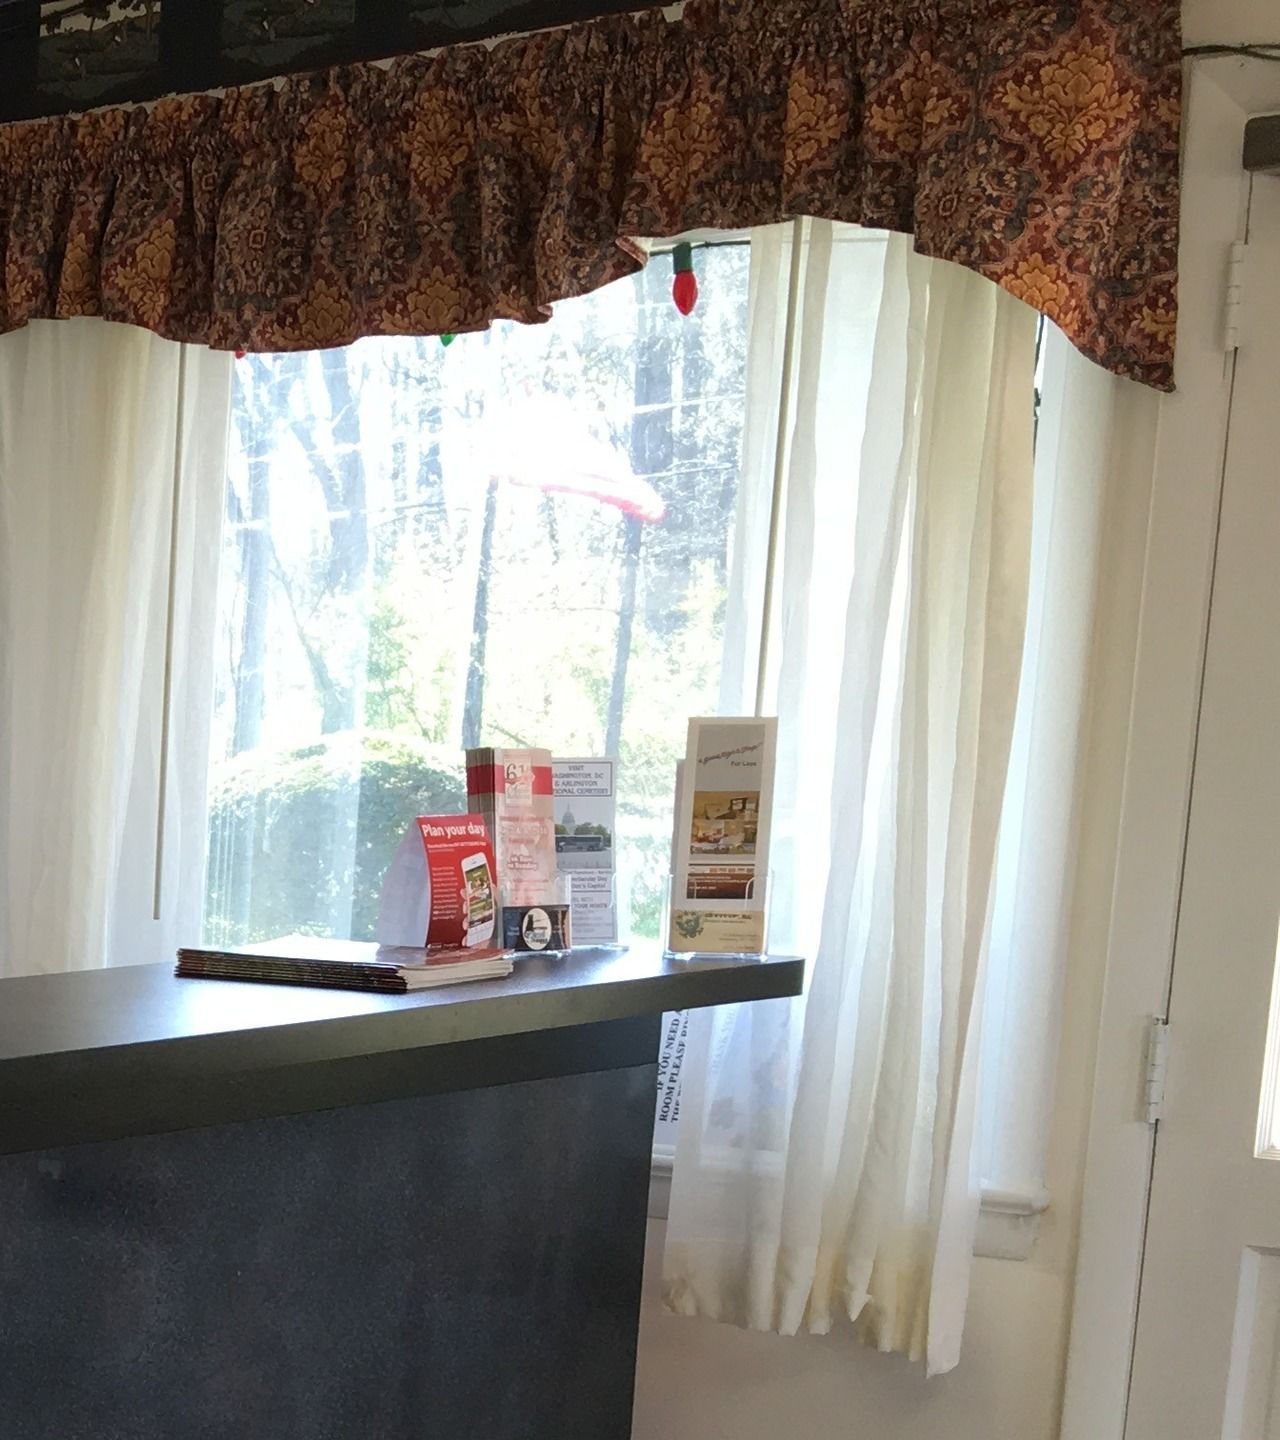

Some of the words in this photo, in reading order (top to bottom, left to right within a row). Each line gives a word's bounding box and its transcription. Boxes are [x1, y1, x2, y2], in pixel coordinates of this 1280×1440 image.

[422, 823, 445, 837] Plan
[445, 823, 467, 840] your
[468, 822, 485, 836] day
[665, 1018, 680, 1050] NEED
[659, 1086, 675, 1122] ROOM
